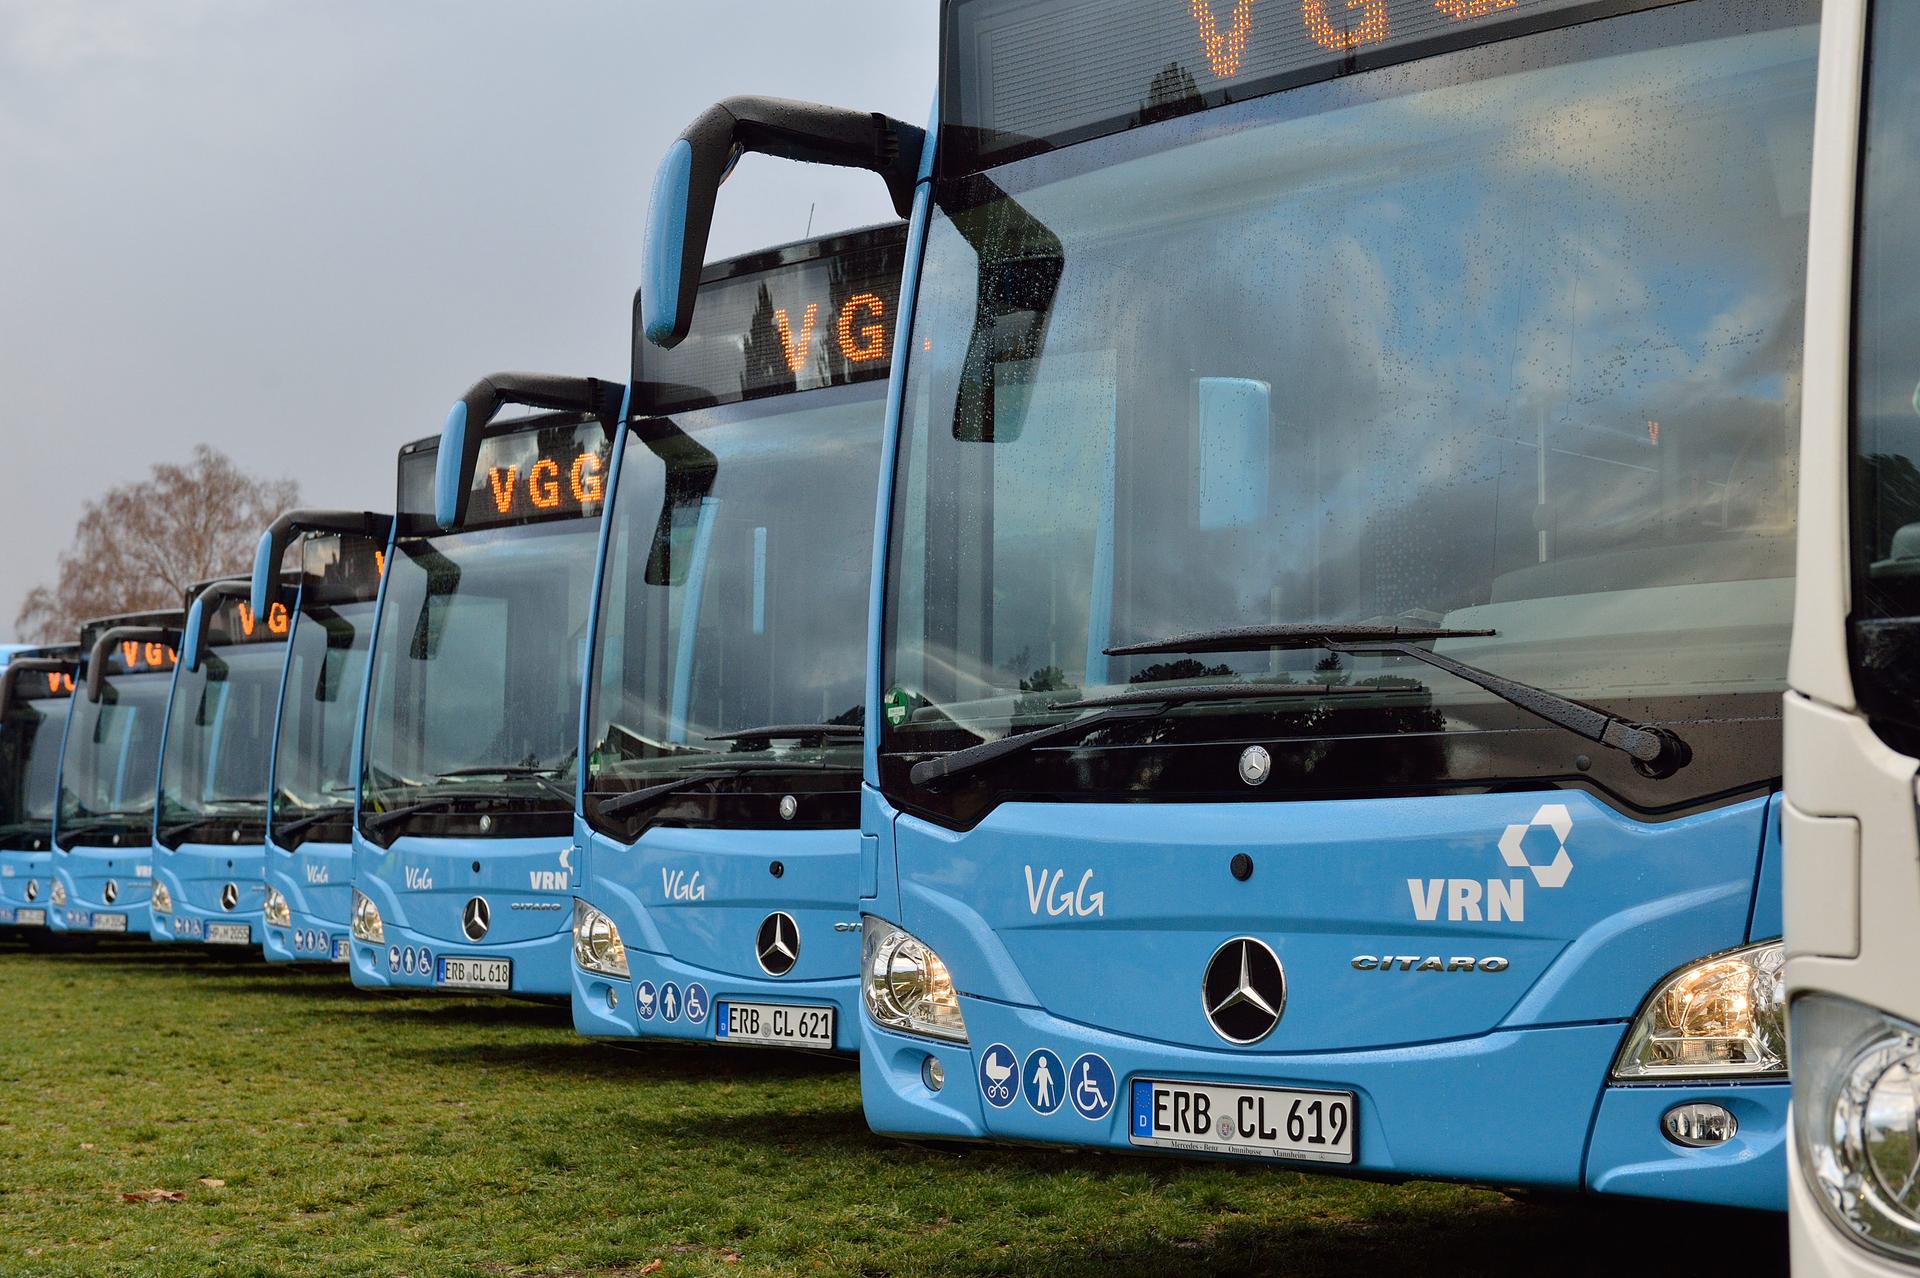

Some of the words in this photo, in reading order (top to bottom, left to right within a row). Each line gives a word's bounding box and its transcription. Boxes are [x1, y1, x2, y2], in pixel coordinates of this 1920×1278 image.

[489, 451, 602, 514] VGG
[405, 865, 432, 890] VGG
[529, 871, 568, 890] VRN
[661, 866, 705, 901] VGG
[1024, 864, 1104, 917] VGG
[511, 902, 562, 911] CITARO
[1407, 878, 1524, 922] VRN
[445, 962, 465, 980] ERB
[472, 963, 486, 982] CL
[488, 964, 508, 983] 618
[1350, 954, 1510, 973] CITARO
[729, 1007, 760, 1035] ERB
[773, 1010, 794, 1037] CL
[799, 1012, 830, 1039] 621
[1154, 1089, 1212, 1135] ERB
[1237, 1096, 1277, 1140] CL
[1286, 1099, 1348, 1145] 619
[1272, 1149, 1307, 1160] Mannheim
